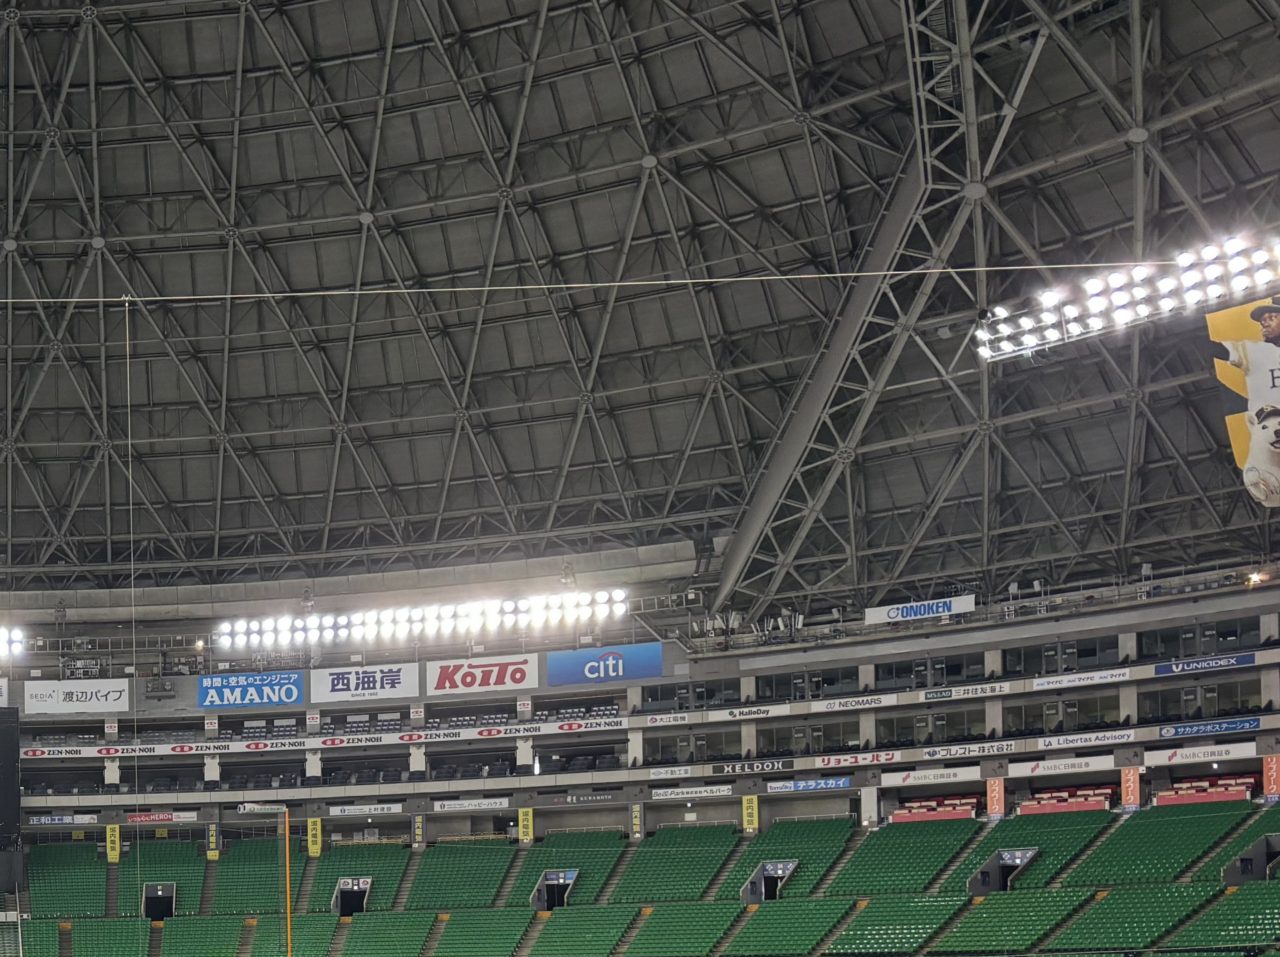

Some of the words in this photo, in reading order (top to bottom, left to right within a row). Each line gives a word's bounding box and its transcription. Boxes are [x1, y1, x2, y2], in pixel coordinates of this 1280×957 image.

[900, 599, 953, 619] ONOKEN
[584, 653, 624, 679] citi
[1184, 657, 1237, 670] UNIADEX
[202, 674, 298, 687] 時間と空気のエンジニア
[328, 667, 403, 693] 西海岸
[203, 684, 299, 706] AMANO
[838, 697, 882, 708] NEOMARS
[1057, 736, 1093, 746] Libertas
[1094, 731, 1132, 745] Advisory
[941, 743, 1013, 757] プレスト株式会社
[821, 752, 895, 766] リョーユーパン
[797, 777, 846, 790] テラスカイ
